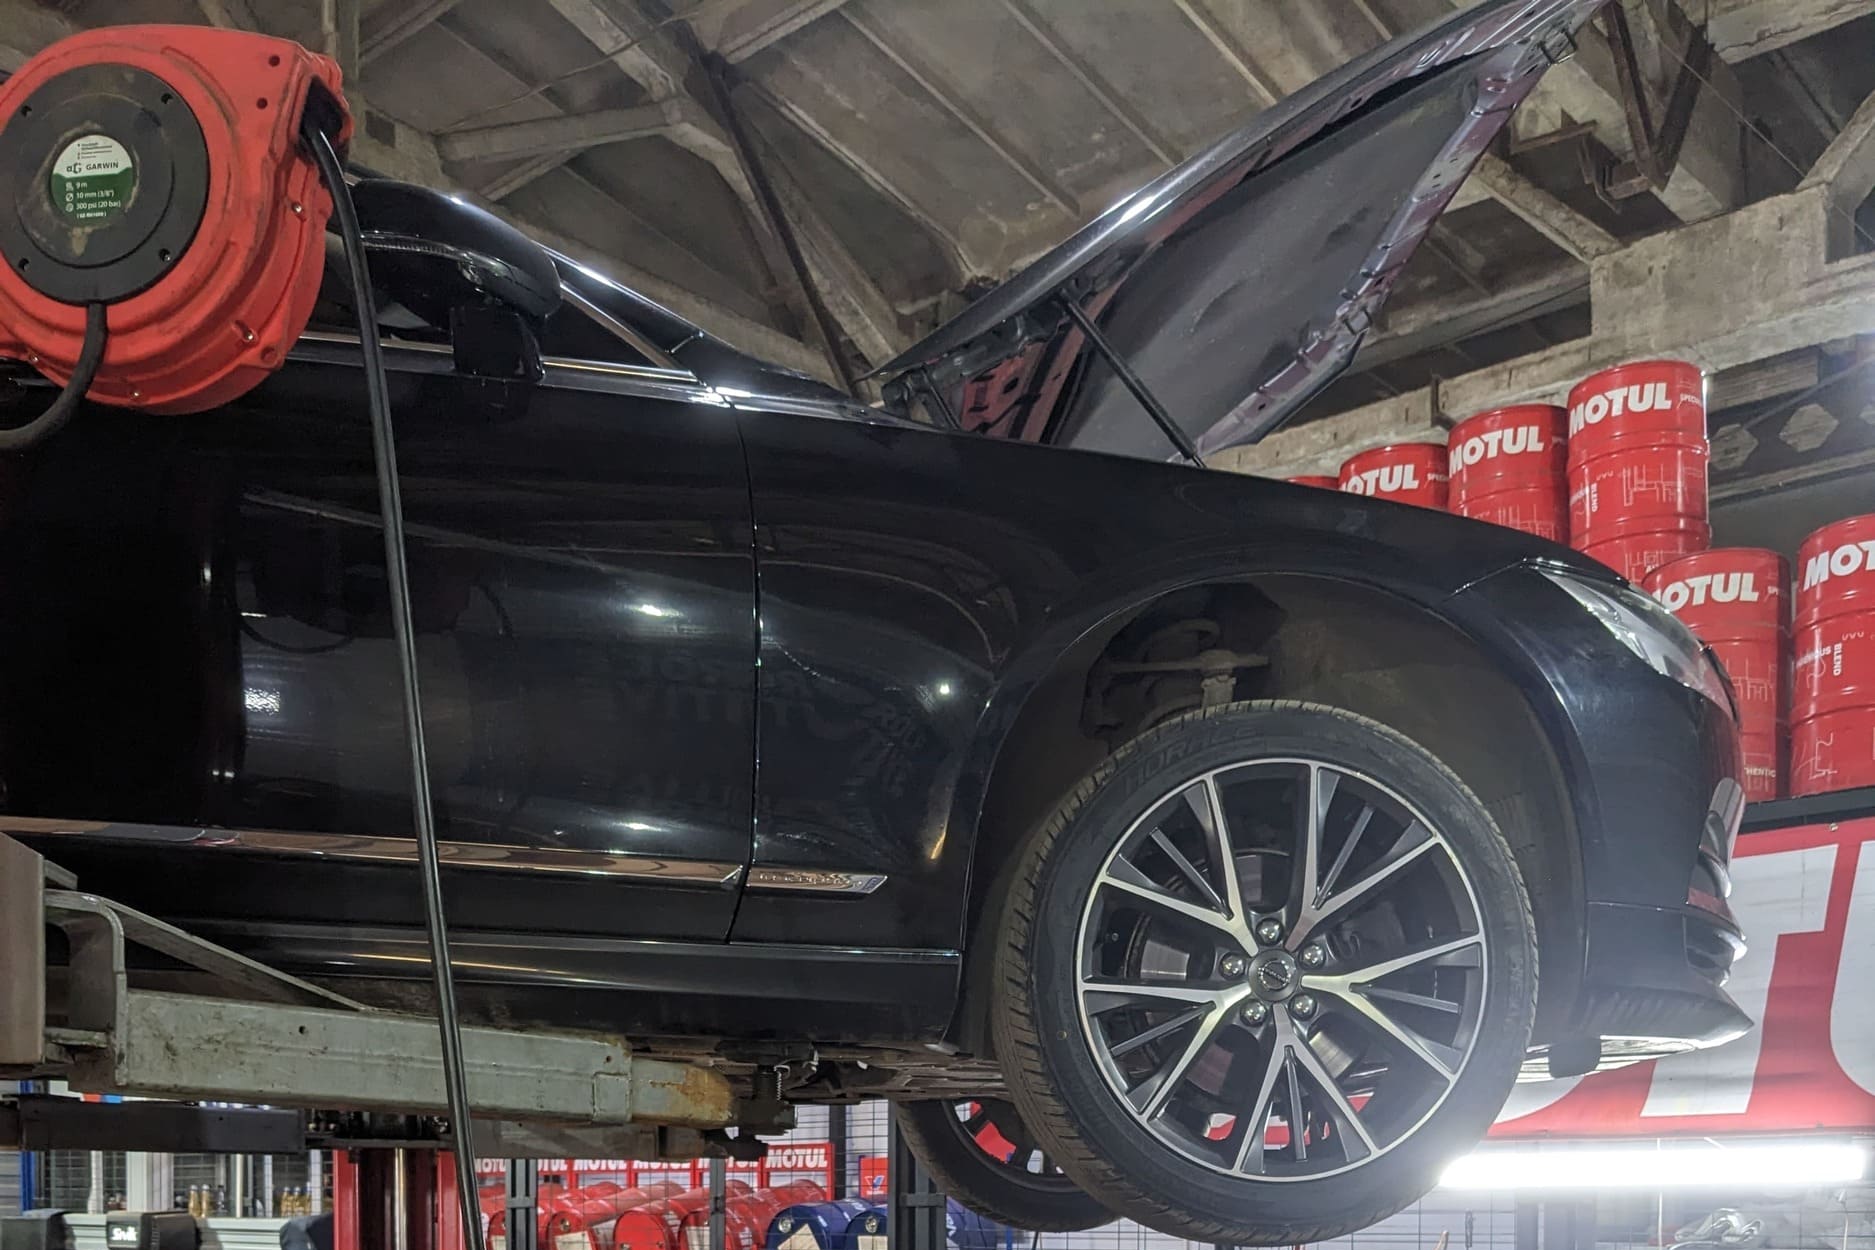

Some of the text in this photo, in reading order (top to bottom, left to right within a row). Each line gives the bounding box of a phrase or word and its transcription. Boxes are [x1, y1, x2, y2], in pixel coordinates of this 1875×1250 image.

[86, 162, 118, 170] GARWIN
[76, 202, 88, 210] 300
[88, 202, 97, 210] psi
[84, 191, 97, 199] mm
[1568, 383, 1672, 438] MOTUL
[1449, 425, 1544, 478] MOTUL
[1339, 464, 1419, 497] OTUL
[1652, 573, 1759, 612] OTUL
[1833, 643, 1843, 676] BLEND
[766, 1149, 827, 1169] MOTUL
